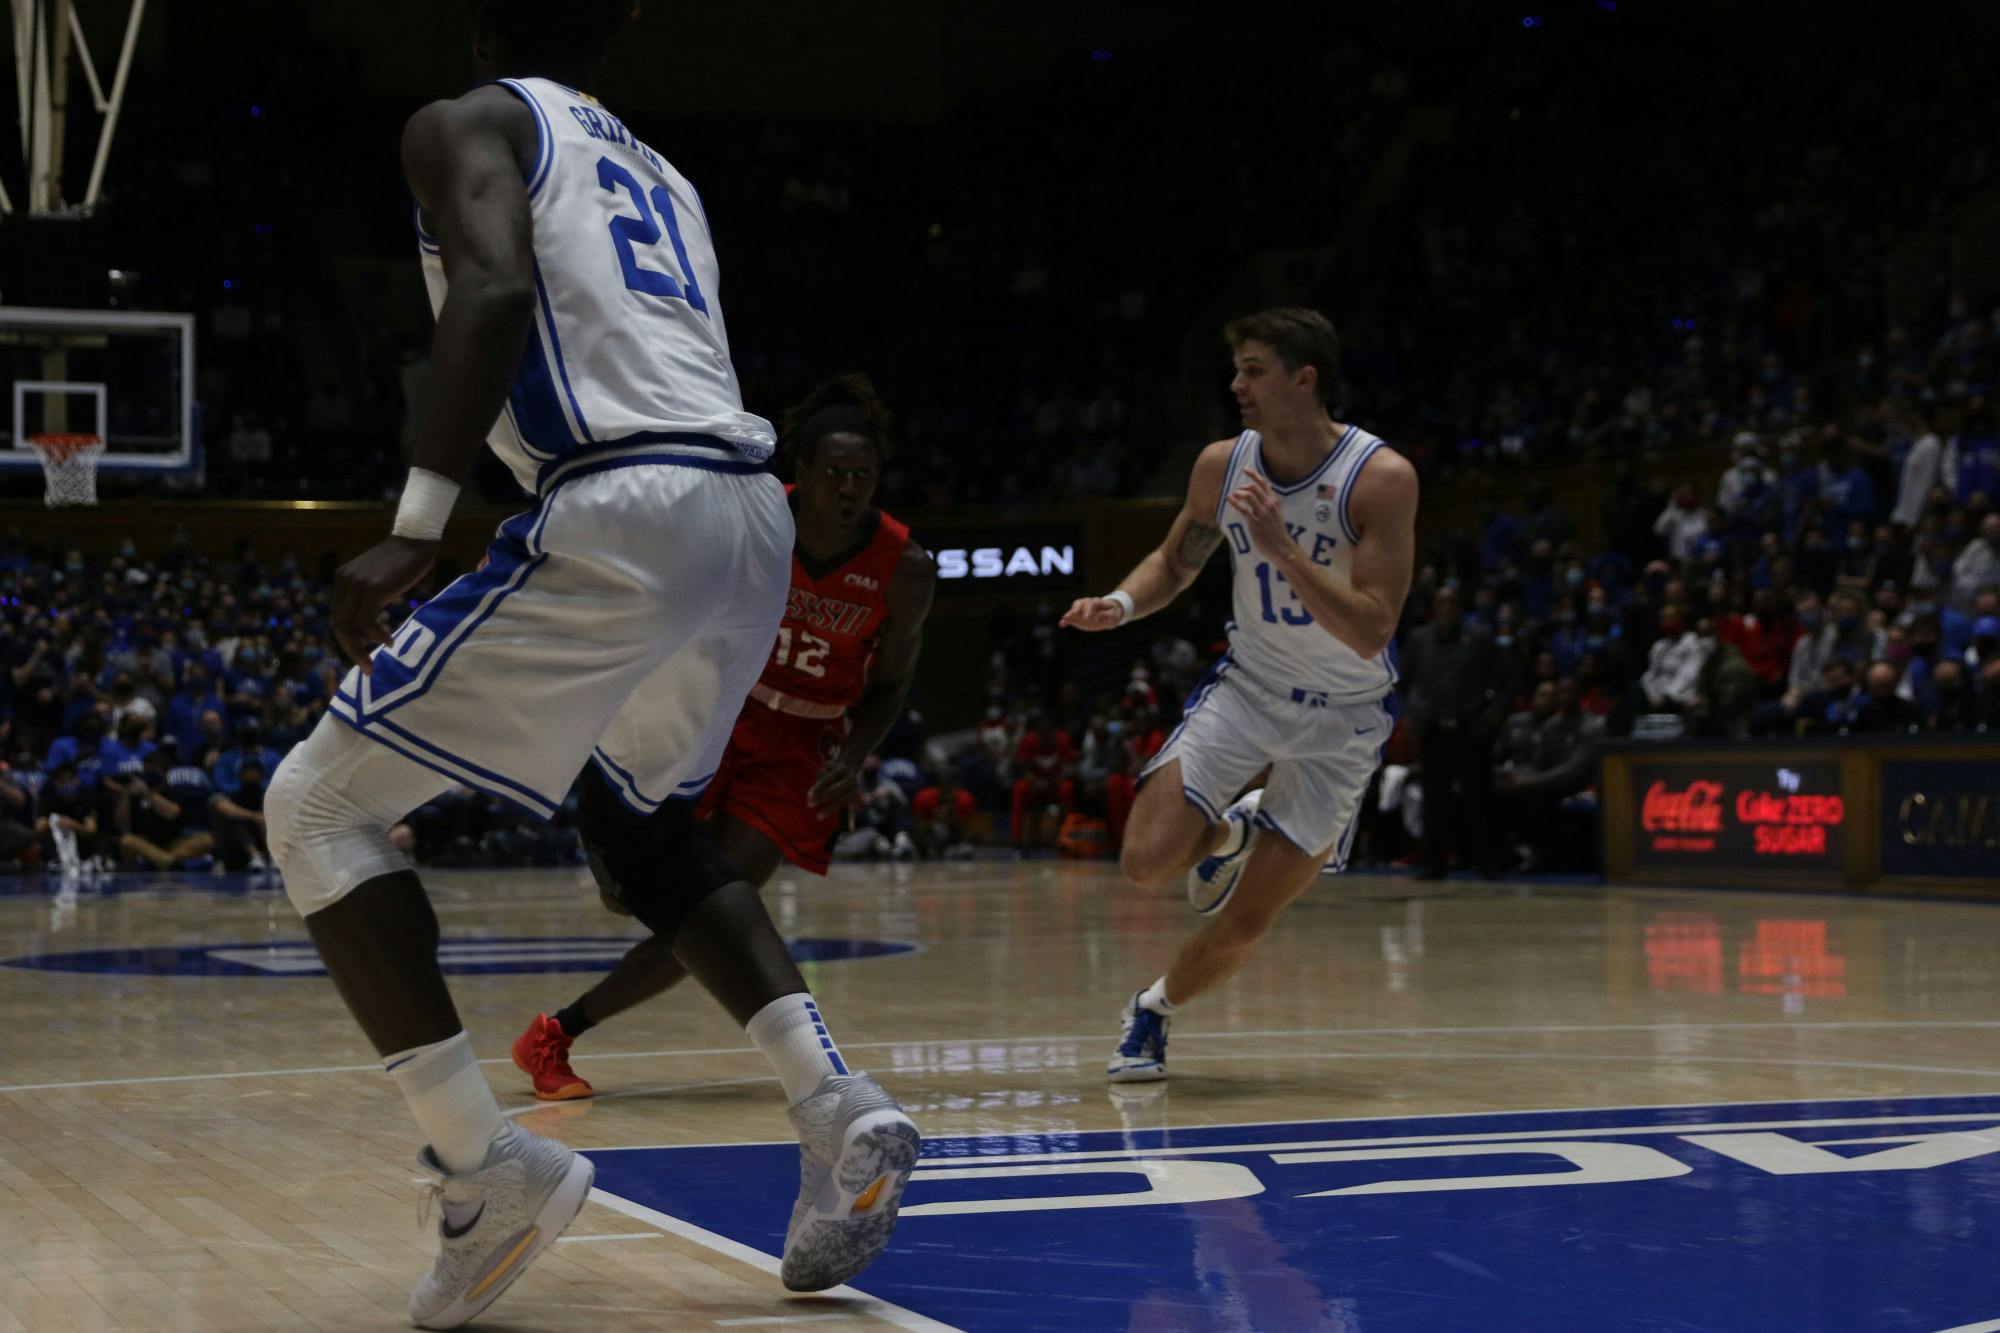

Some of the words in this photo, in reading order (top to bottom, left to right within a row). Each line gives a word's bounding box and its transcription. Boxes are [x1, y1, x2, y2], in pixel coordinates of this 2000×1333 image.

[597, 156, 710, 320] 21
[926, 545, 1074, 579] SSAN
[1228, 523, 1336, 566] DKE
[785, 587, 873, 636] SSU
[776, 627, 831, 678] 12
